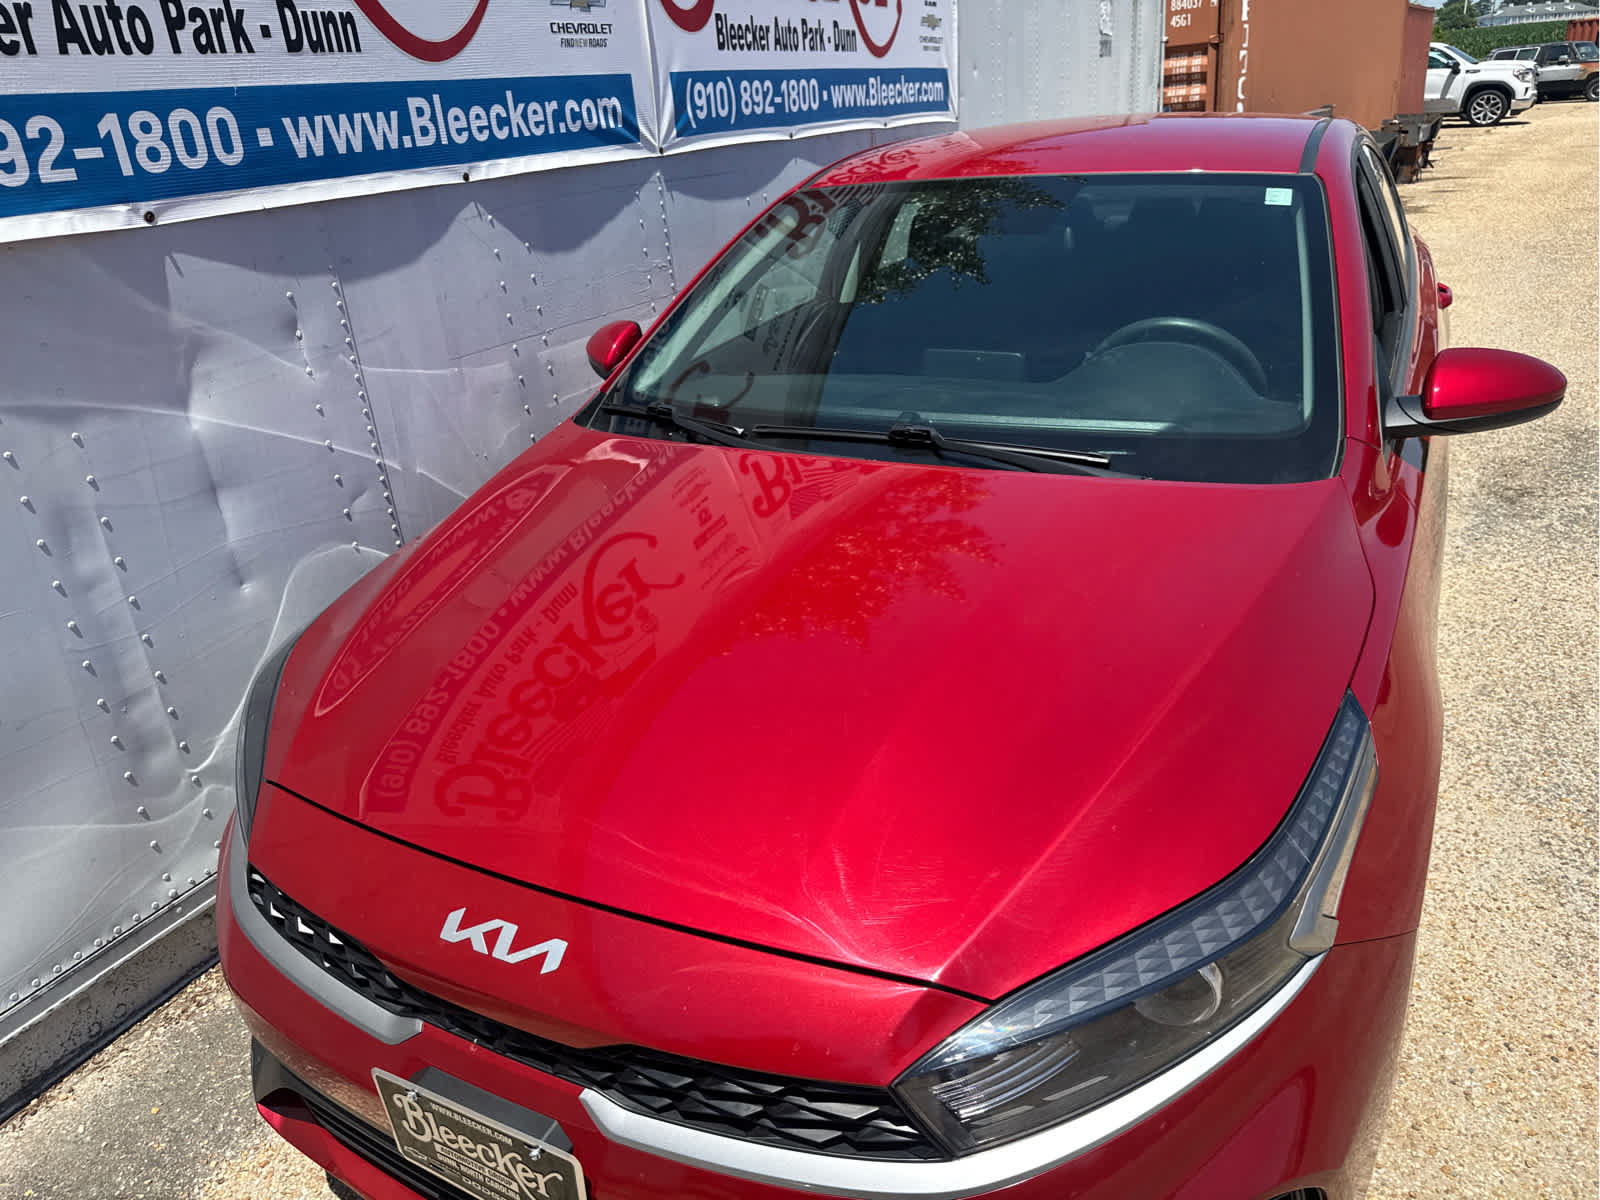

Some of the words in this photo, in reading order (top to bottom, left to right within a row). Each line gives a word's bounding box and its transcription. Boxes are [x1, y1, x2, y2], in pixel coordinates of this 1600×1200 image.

[51, 0, 154, 55] Auto
[161, 0, 255, 54] Park
[277, 0, 362, 53] Dunn
[549, 22, 613, 35] CHEVROLET
[714, 12, 771, 51] Bleecker
[774, 16, 799, 52] Auto
[801, 18, 826, 51] Park
[833, 20, 858, 53] Dunn
[281, 90, 623, 159] www.Bleecker.com
[686, 76, 736, 129] (910)
[740, 78, 820, 116] 892-1800
[830, 74, 944, 109] www.Bleecker.com
[392, 1093, 564, 1200] Bleecker
